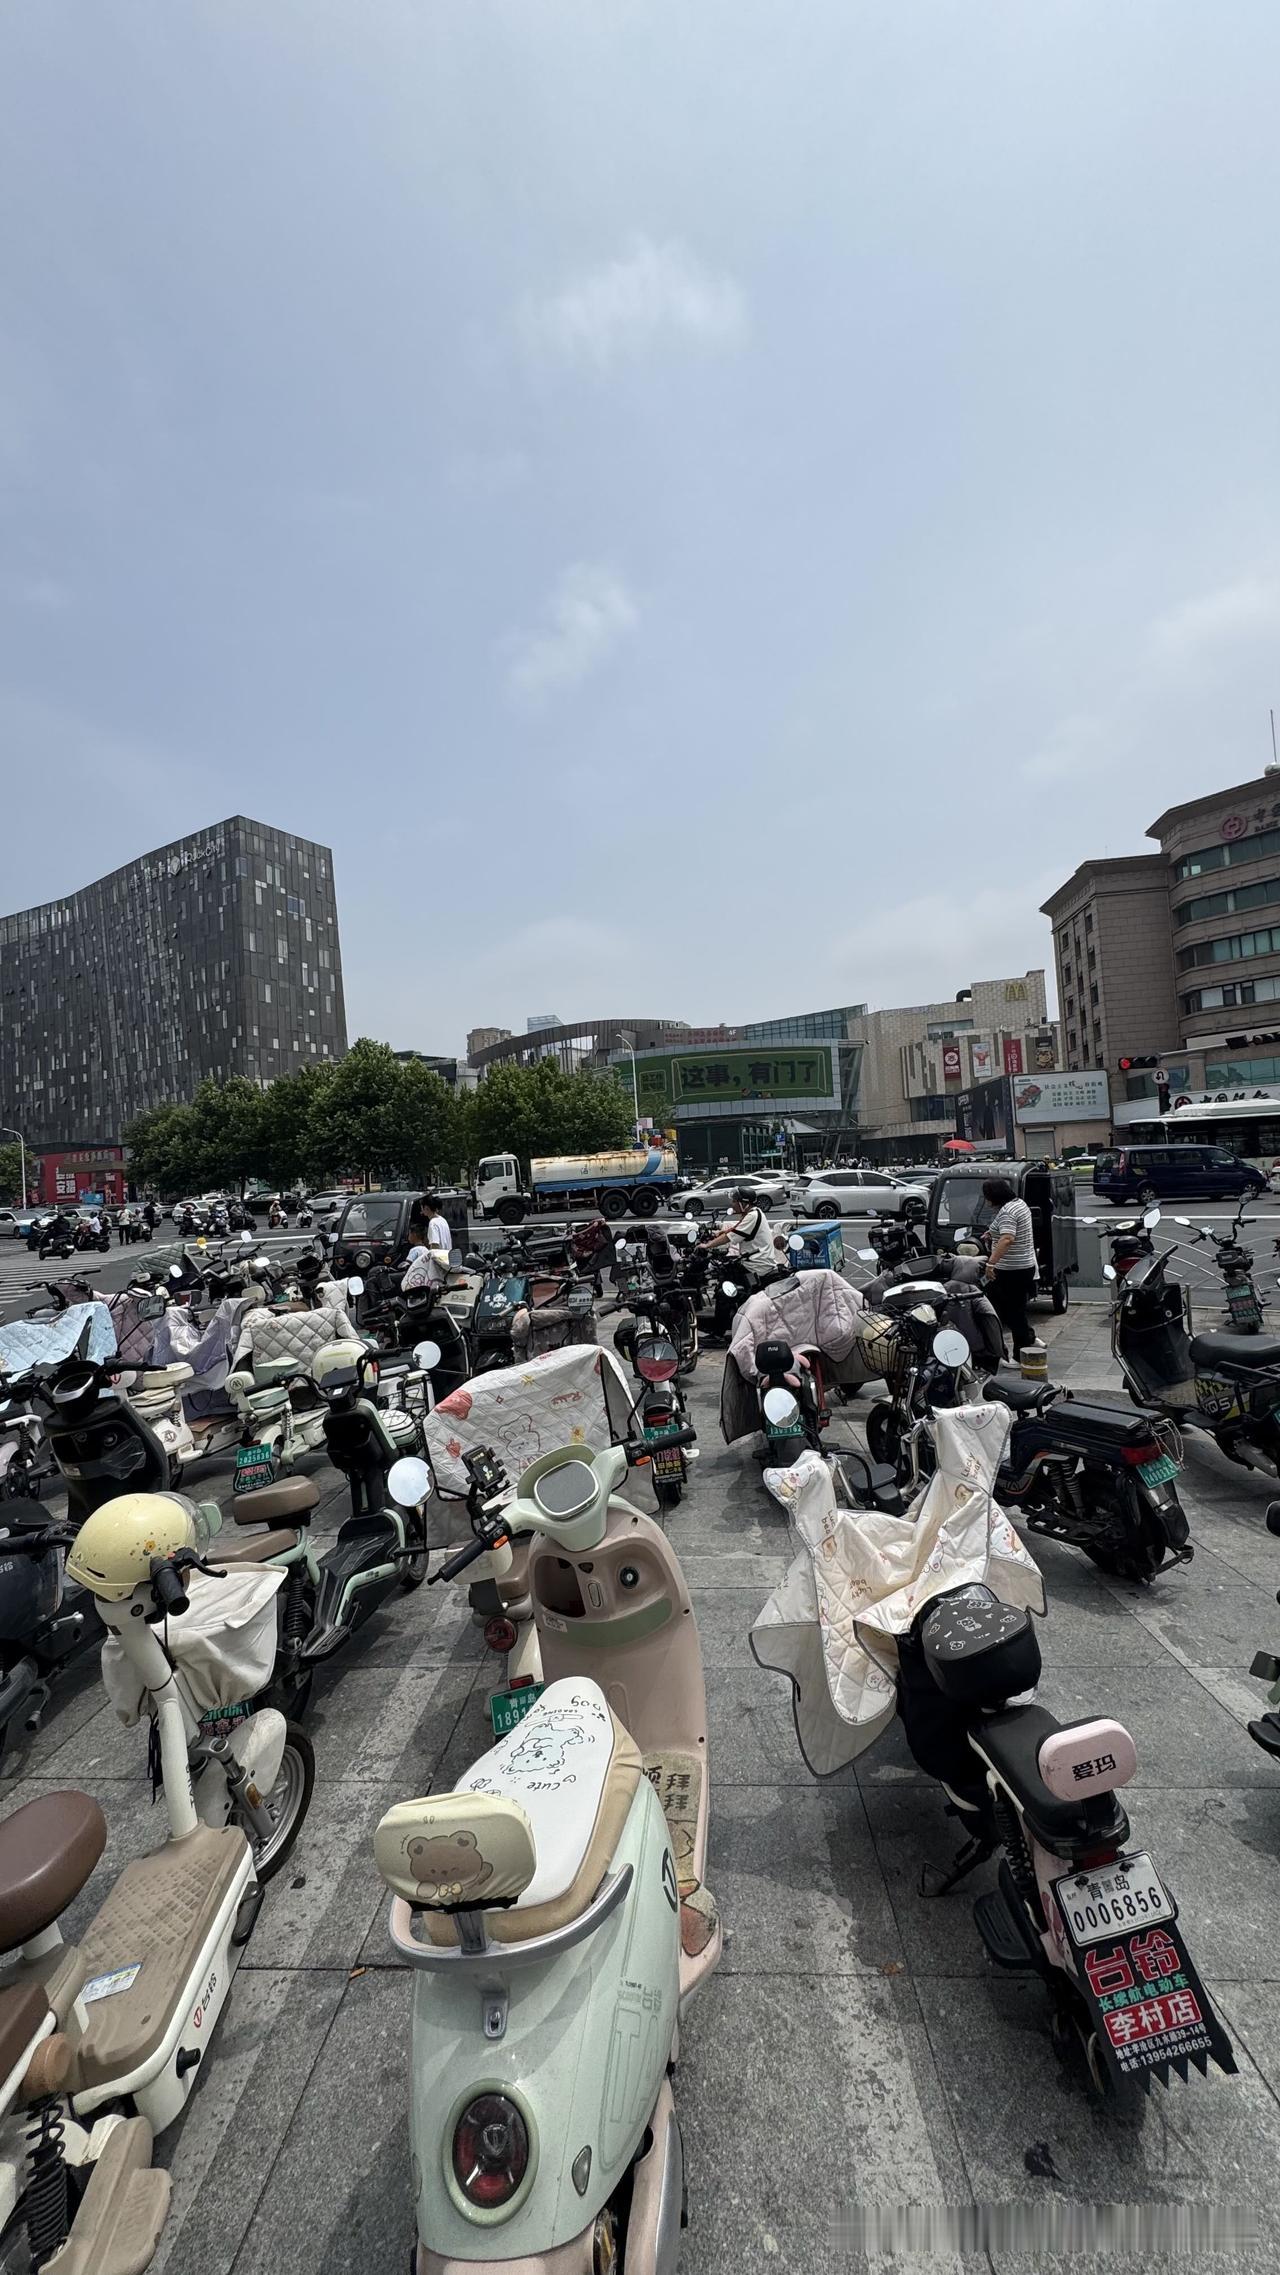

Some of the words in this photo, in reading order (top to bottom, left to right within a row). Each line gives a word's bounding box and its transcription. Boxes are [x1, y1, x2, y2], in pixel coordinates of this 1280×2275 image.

[527, 1782, 561, 1791] cute
[1071, 1753, 1117, 1782] 爱玛
[1073, 1886, 1162, 1932] 0006856
[1084, 1928, 1181, 1998] 台铃
[1099, 1973, 1190, 2013] 长续航电动车
[1109, 1994, 1196, 2042] 李村店
